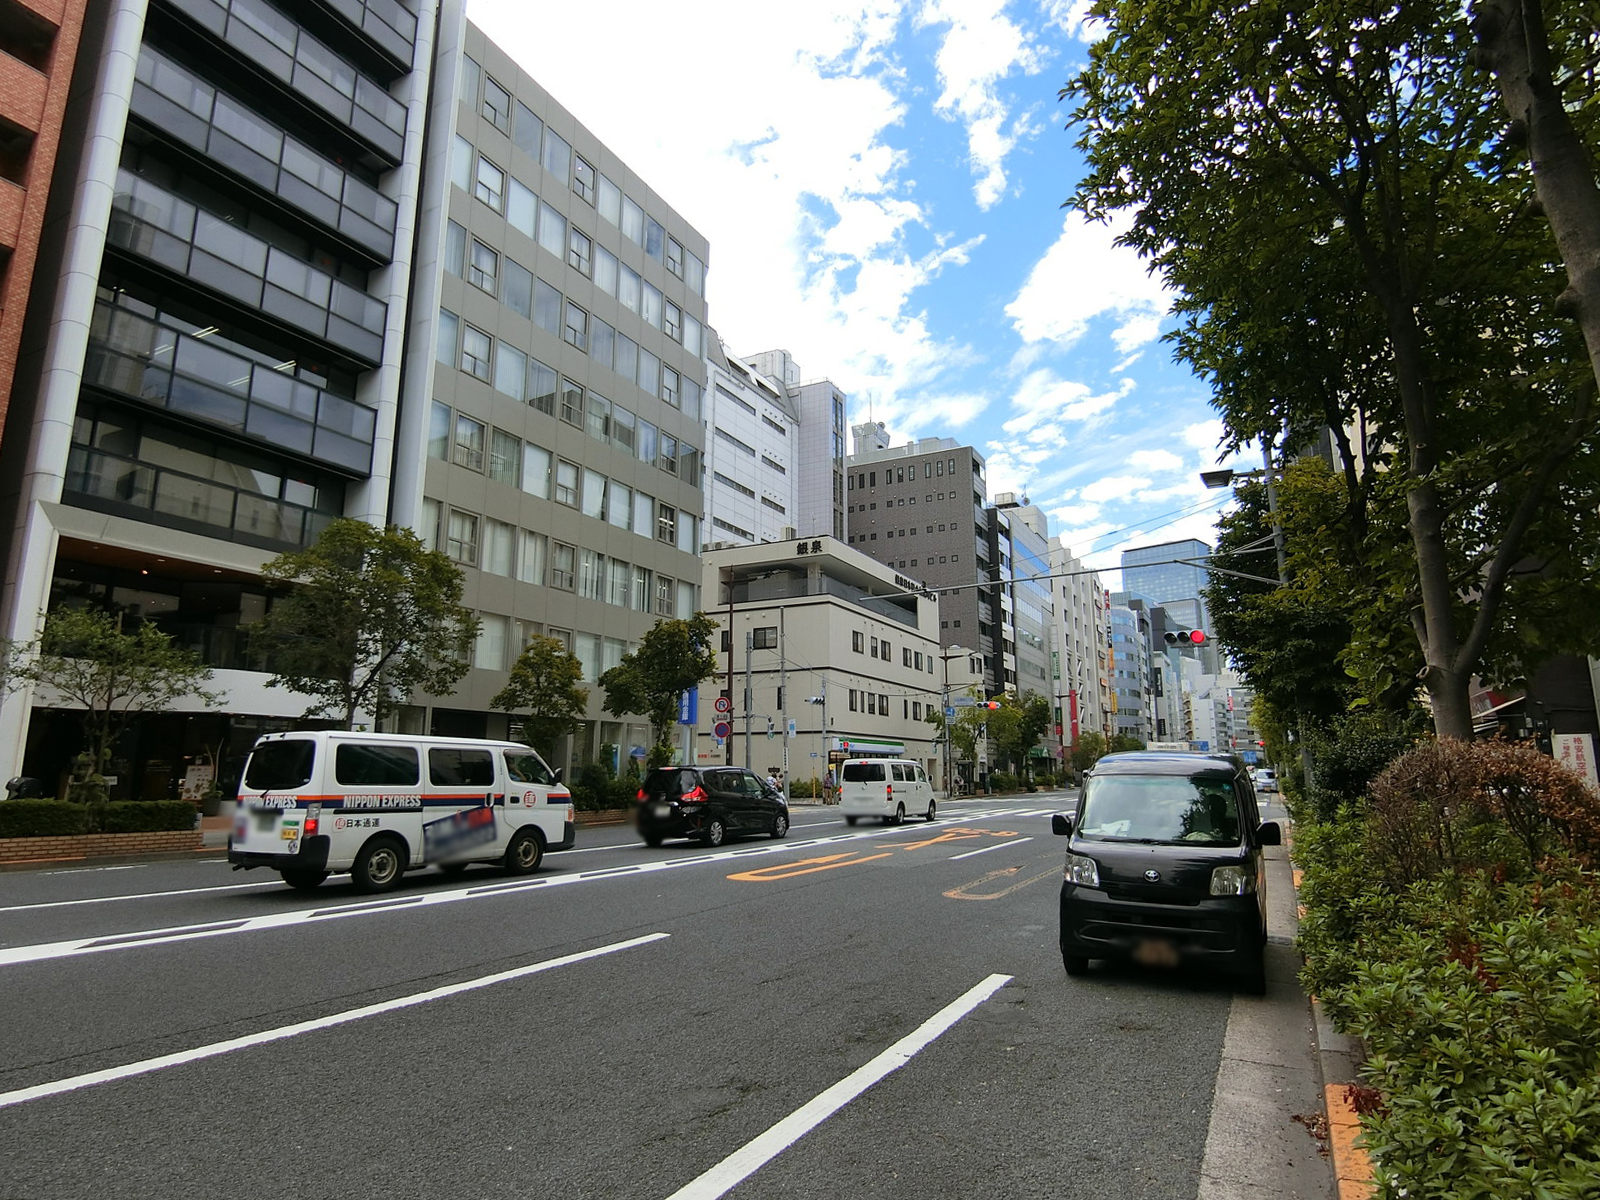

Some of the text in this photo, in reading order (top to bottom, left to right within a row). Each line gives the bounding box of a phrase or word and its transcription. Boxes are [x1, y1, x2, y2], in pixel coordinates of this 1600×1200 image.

[265, 796, 297, 809] EXPRESS
[343, 795, 421, 808] NIPPON EXPRESS
[346, 818, 380, 828] 日本通運
